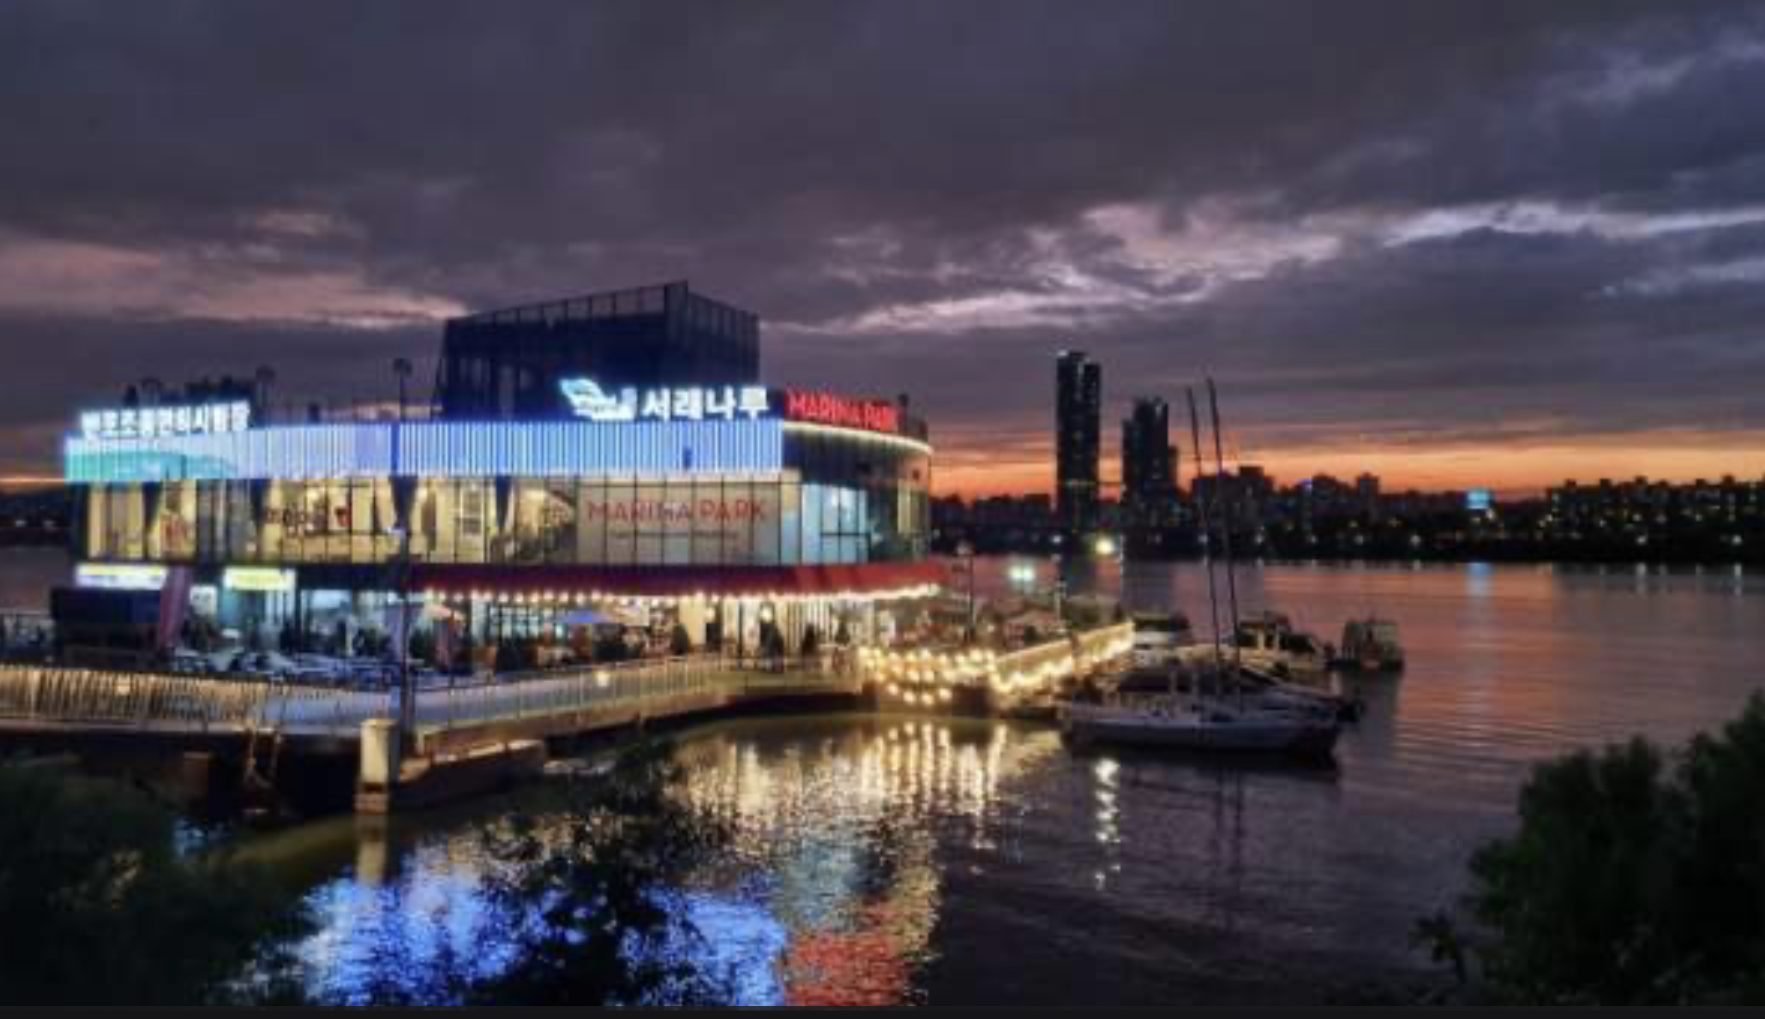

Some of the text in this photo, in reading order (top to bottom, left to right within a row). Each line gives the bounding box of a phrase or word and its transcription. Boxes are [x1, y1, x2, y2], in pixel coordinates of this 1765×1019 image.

[788, 391, 860, 424] MARINA
[587, 498, 770, 522] MARINA PARK
